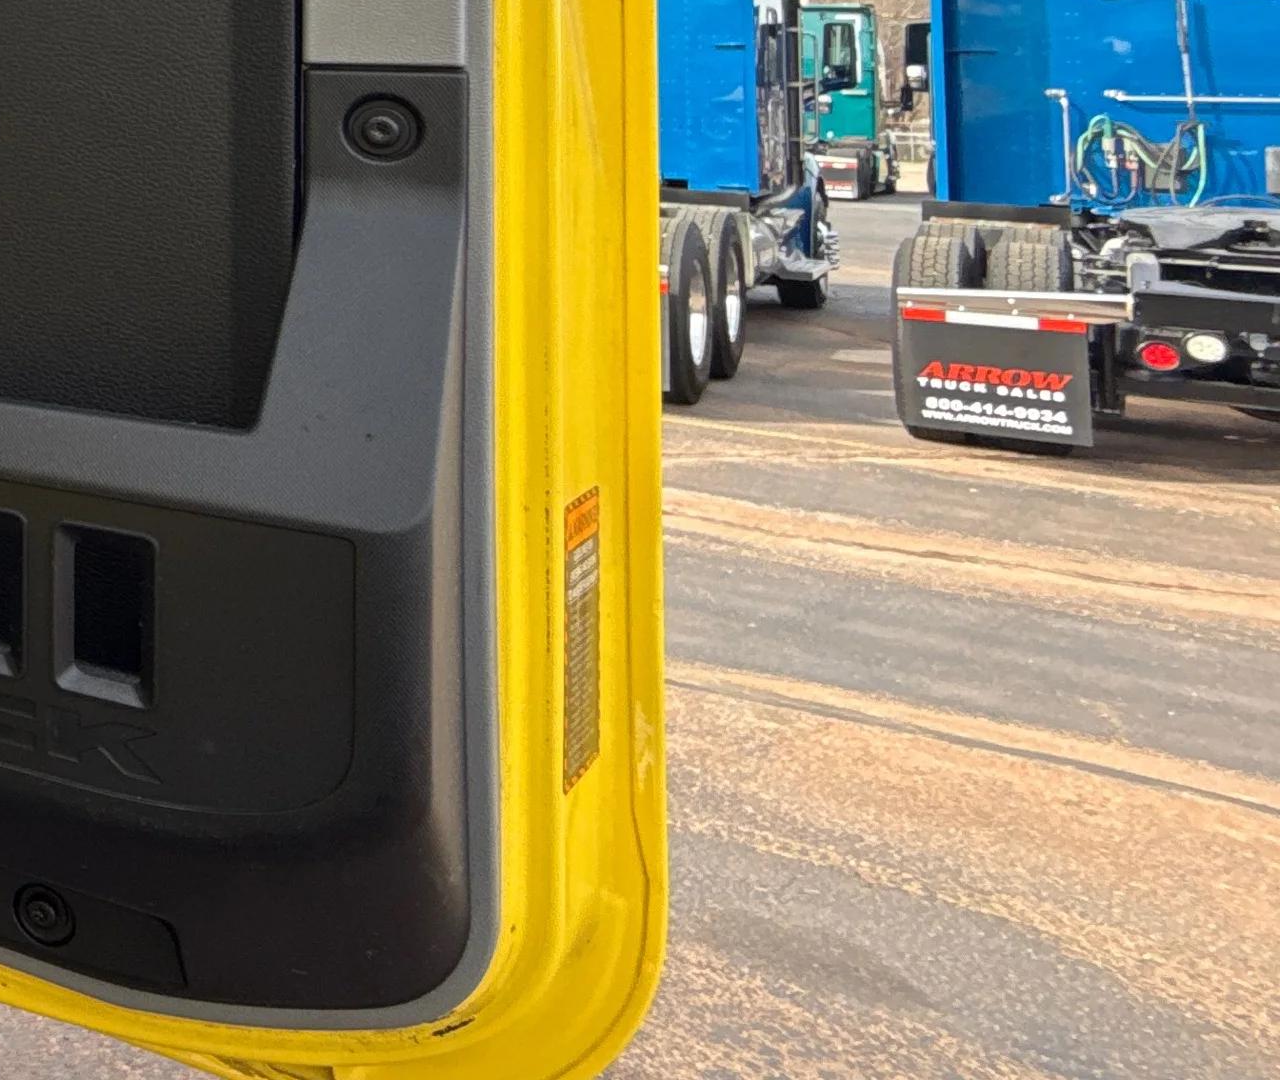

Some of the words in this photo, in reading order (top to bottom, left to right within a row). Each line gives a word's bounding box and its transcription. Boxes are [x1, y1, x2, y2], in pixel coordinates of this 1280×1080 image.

[916, 360, 1074, 391] ARROW
[916, 376, 988, 394] TRUCK
[996, 385, 1066, 403] SALES
